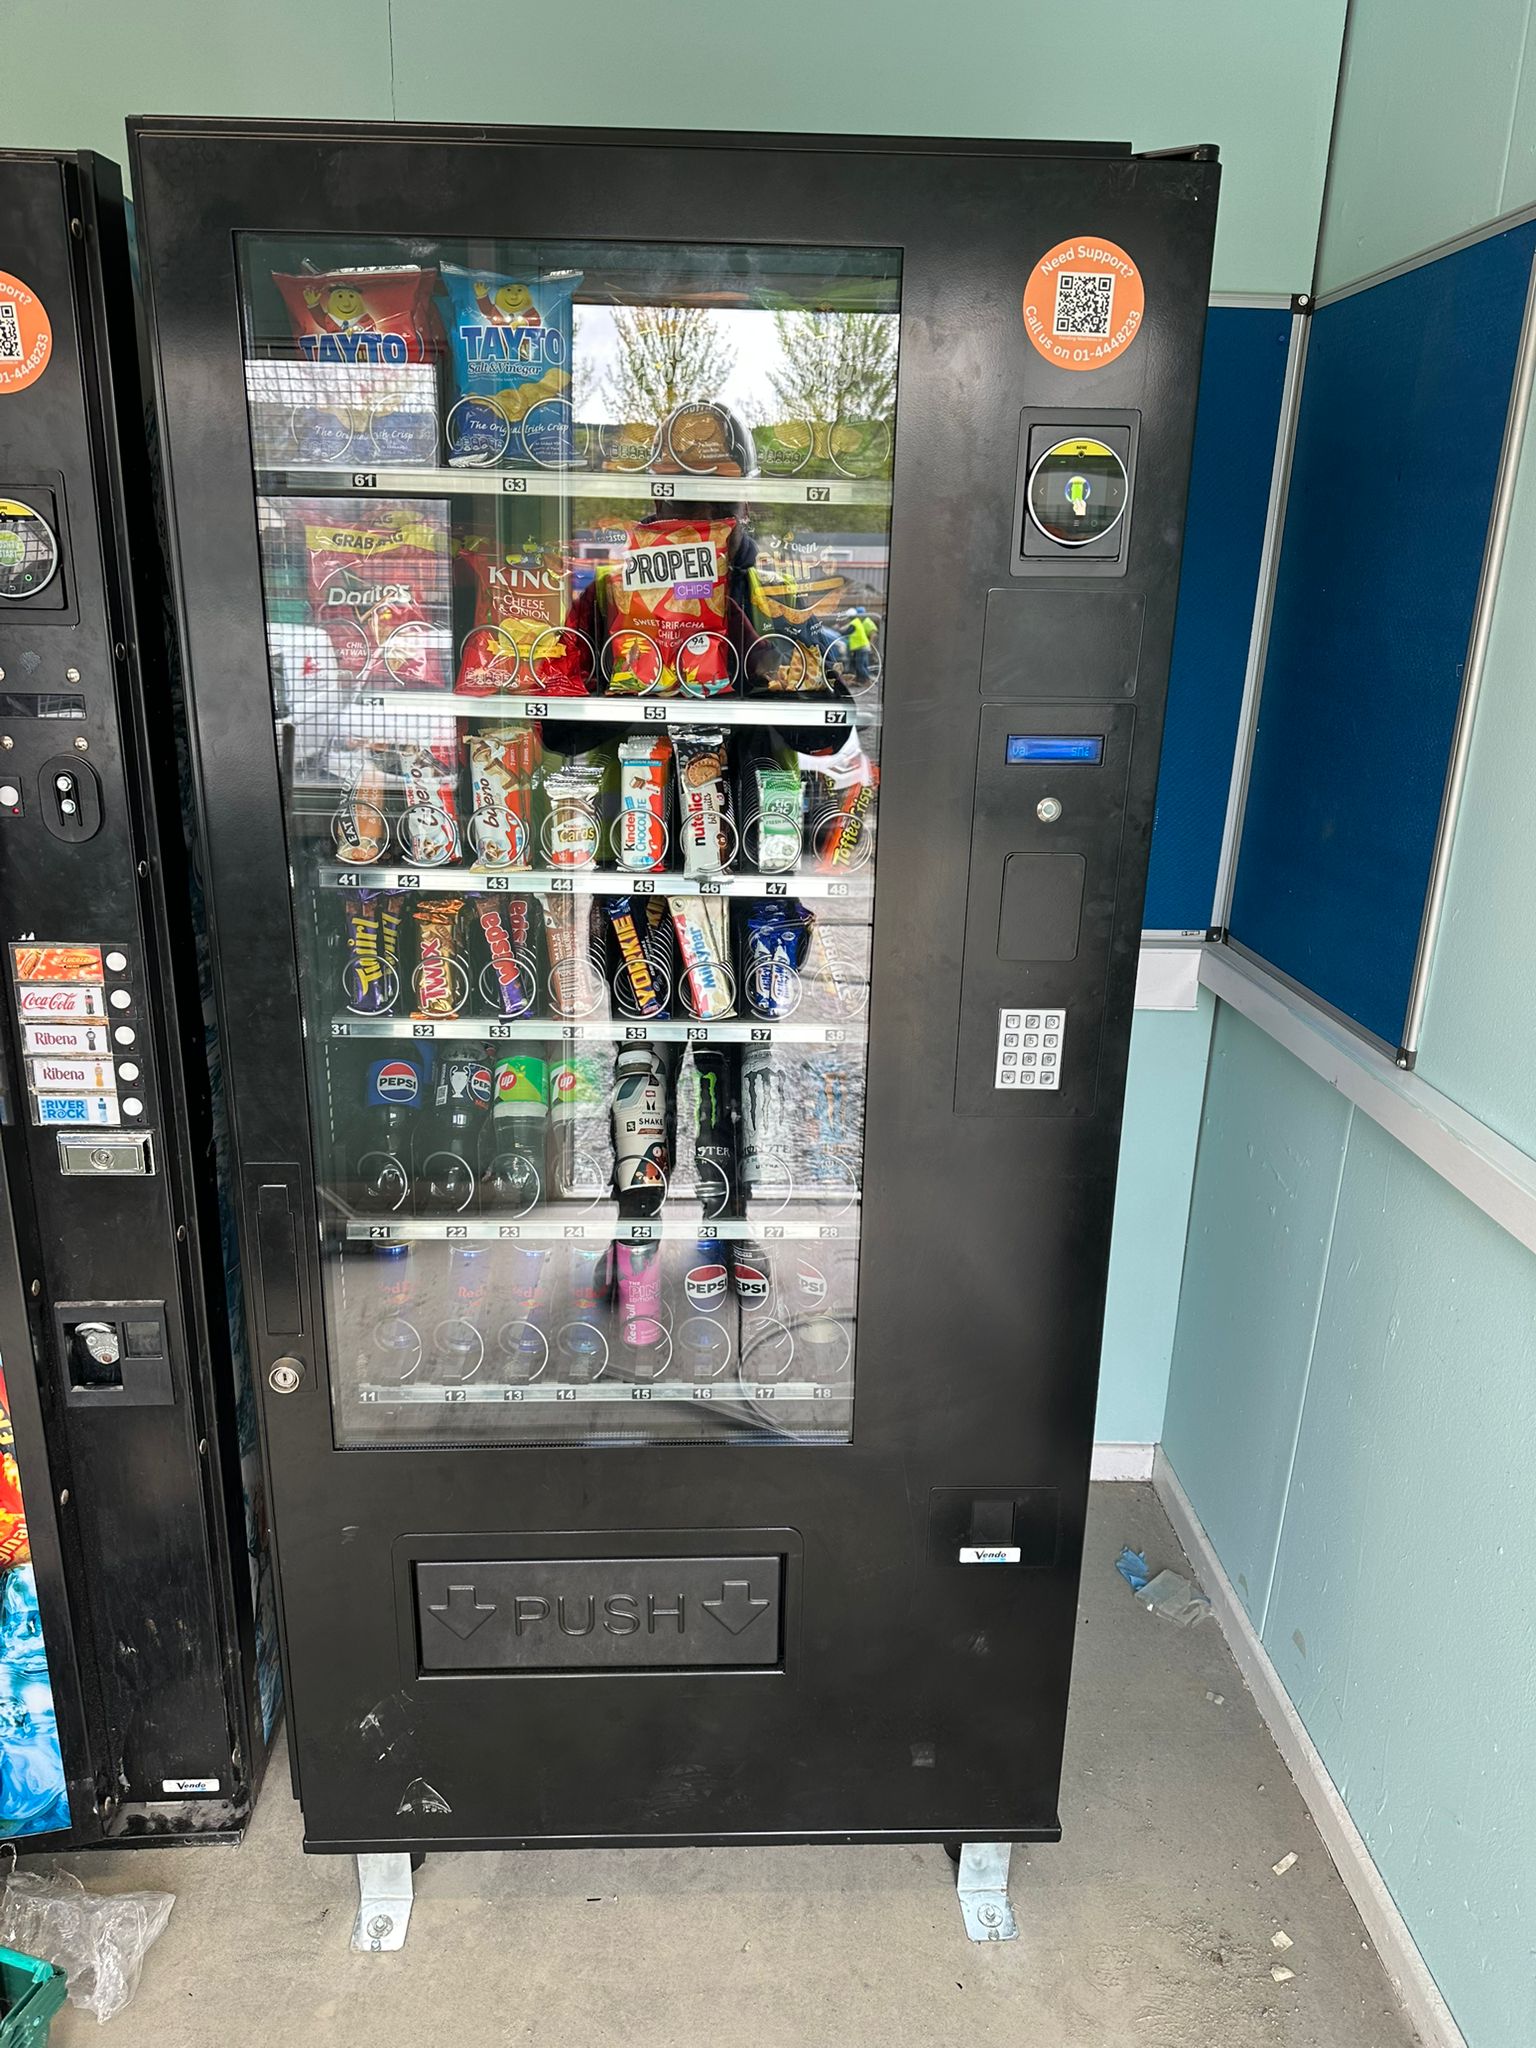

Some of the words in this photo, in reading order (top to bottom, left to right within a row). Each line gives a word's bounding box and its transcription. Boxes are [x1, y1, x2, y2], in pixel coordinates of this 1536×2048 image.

[1040, 247, 1075, 276] Need
[1077, 245, 1134, 278] Support?
[1025, 305, 1043, 335] Call
[1038, 333, 1053, 349] us
[1053, 345, 1070, 359] on
[1073, 310, 1141, 361] 01-4448233
[299, 332, 409, 364] TAYTO
[461, 325, 566, 365] TAYTO
[0, 333, 49, 383] 1-4448233
[468, 362, 488, 374] Salt
[497, 362, 542, 377] Vinegar
[469, 420, 487, 430] The
[547, 423, 569, 435] Crisp
[354, 474, 373, 487] 61
[504, 479, 525, 491] 63
[653, 483, 674, 496] 65
[808, 488, 829, 500] 67
[331, 532, 375, 549] GRAB
[625, 546, 715, 586] PROPER
[487, 565, 566, 592] KING
[327, 583, 412, 606] Doritos
[677, 583, 711, 597] CHIPS
[503, 594, 545, 610] CHEESE
[509, 605, 550, 621] ONION
[632, 618, 660, 627] SWEET
[527, 704, 547, 716] 53
[645, 707, 665, 719] 55
[826, 711, 846, 723] 57
[480, 777, 500, 829] bueno
[775, 799, 791, 807] tic
[771, 806, 790, 814] tac
[636, 798, 647, 852] CHOCOLTE
[688, 792, 707, 847] nutella
[342, 821, 358, 843] EAT
[831, 817, 862, 866] Toffee
[338, 874, 357, 885] 41
[399, 876, 419, 887] 42
[488, 878, 508, 889] 43
[552, 880, 572, 890] 44
[634, 881, 654, 892] 45
[701, 883, 720, 893] 46
[767, 883, 786, 894] 47
[829, 884, 848, 895] 48
[480, 911, 520, 986] Wispa
[348, 917, 383, 997] Twirl
[612, 915, 657, 1008] YORKIE
[419, 937, 450, 1009] TWIX
[21, 991, 78, 1011] Coca-Cola
[331, 1024, 349, 1035] 31
[415, 1025, 433, 1036] 32
[490, 1027, 510, 1037] 33
[562, 1027, 583, 1038] 34
[627, 1028, 646, 1039] 35
[688, 1029, 707, 1040] 36
[752, 1030, 771, 1040] 37
[34, 1031, 78, 1046] Ribena
[827, 1030, 845, 1041] 38
[43, 1067, 85, 1081] Ribena
[379, 1077, 416, 1089] PEPSI
[46, 1099, 85, 1110] RIVER
[46, 1109, 86, 1120] ROCK
[638, 1118, 664, 1126] SHAKE
[371, 1227, 389, 1237] 21
[448, 1227, 466, 1237] 22
[501, 1227, 519, 1237] 23
[566, 1227, 584, 1237] 24
[633, 1227, 651, 1238] 25
[698, 1227, 717, 1238] 26
[766, 1227, 783, 1237] 27
[820, 1227, 838, 1237] 28
[687, 1279, 727, 1294] PEPSI
[736, 1280, 767, 1294] EPSI
[627, 1320, 637, 1343] Red
[360, 1391, 377, 1401] 11
[446, 1391, 466, 1401] 12
[505, 1391, 522, 1400] 13
[558, 1390, 575, 1400] 14
[634, 1389, 651, 1399] 15
[695, 1389, 711, 1399] 16
[758, 1389, 775, 1398] 17
[815, 1389, 831, 1398] 18
[974, 1549, 1007, 1560] Vendo
[514, 1592, 686, 1637] PUSH
[176, 1781, 207, 1790] Vendo
